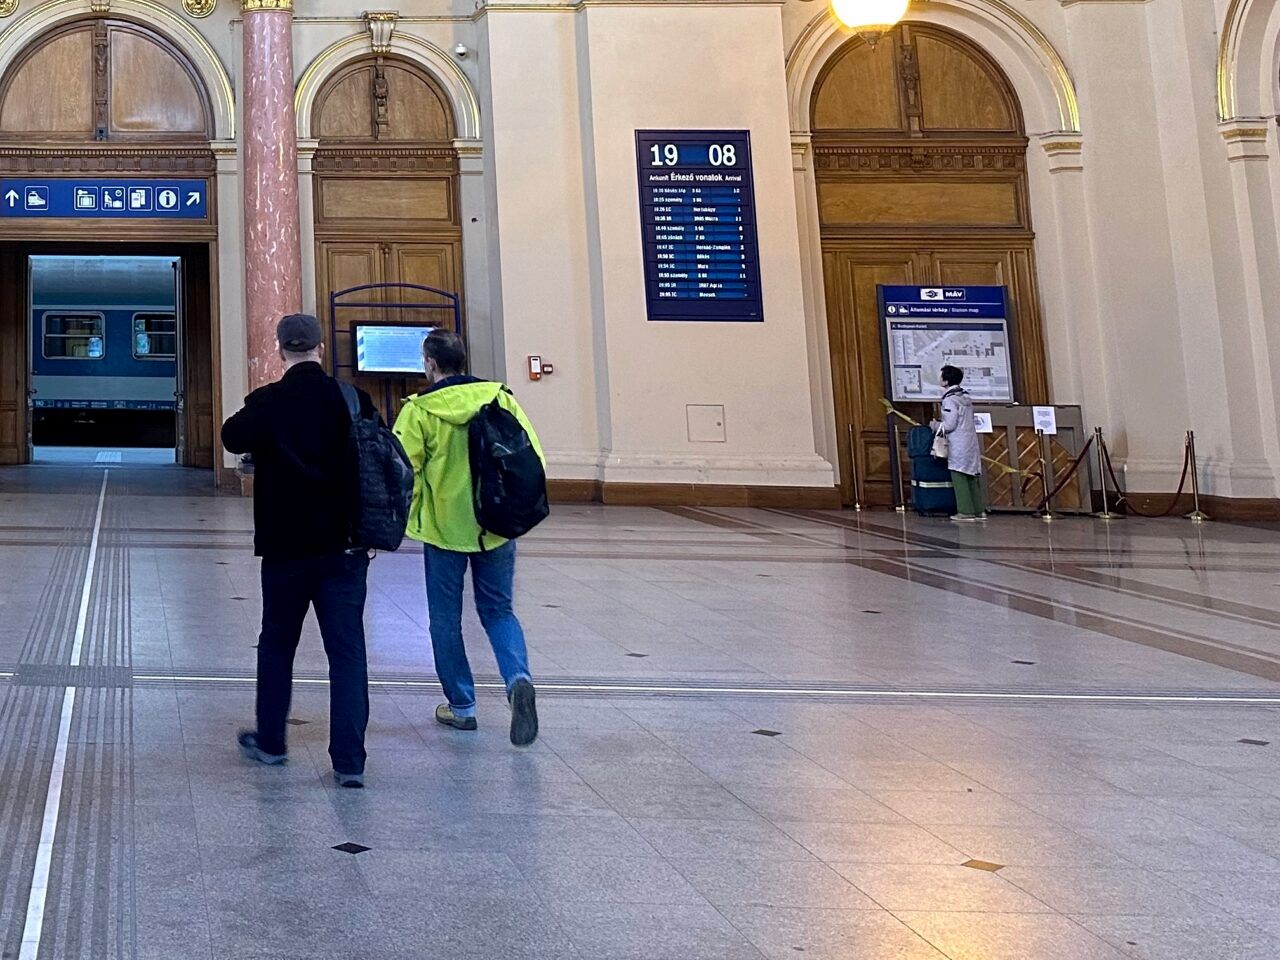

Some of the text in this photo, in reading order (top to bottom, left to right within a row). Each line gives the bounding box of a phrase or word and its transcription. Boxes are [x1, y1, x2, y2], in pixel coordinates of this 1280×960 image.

[651, 144, 736, 166] 19 08
[671, 172, 693, 181] Érkező
